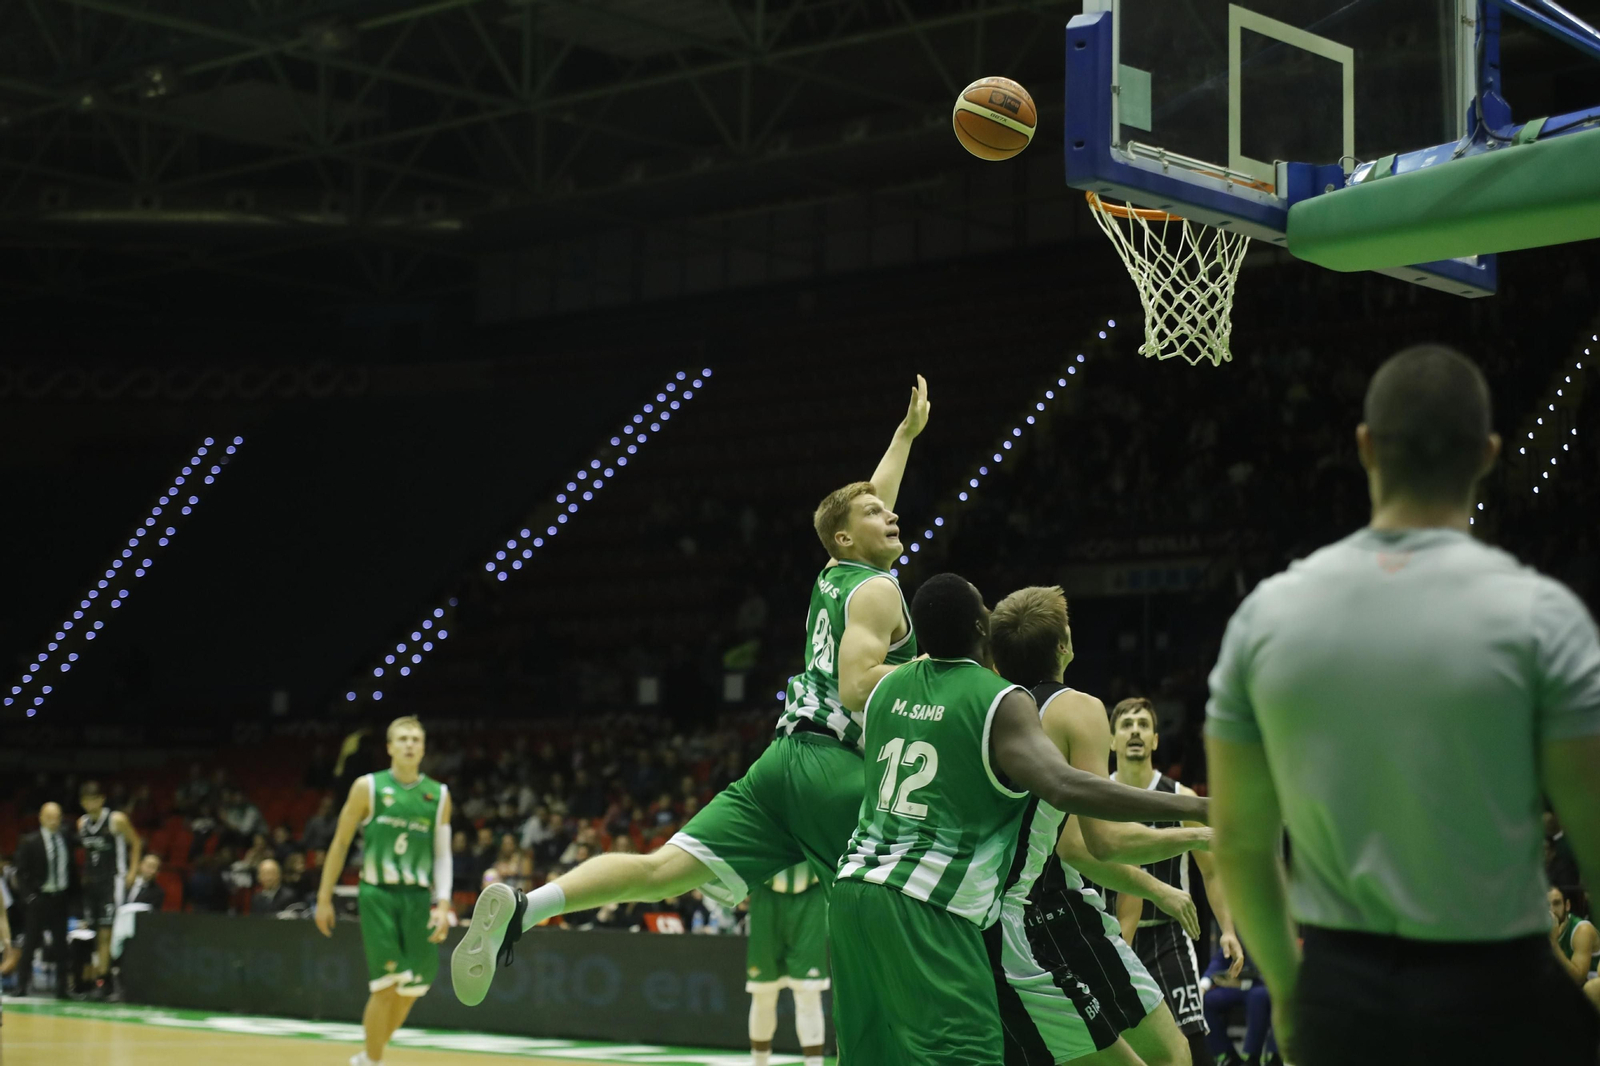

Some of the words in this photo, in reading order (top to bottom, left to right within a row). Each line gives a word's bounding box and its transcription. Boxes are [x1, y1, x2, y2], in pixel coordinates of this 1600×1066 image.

[876, 737, 939, 821] 12
[393, 832, 409, 856] 6
[643, 968, 727, 1015] en
[1172, 984, 1201, 1015] 25
